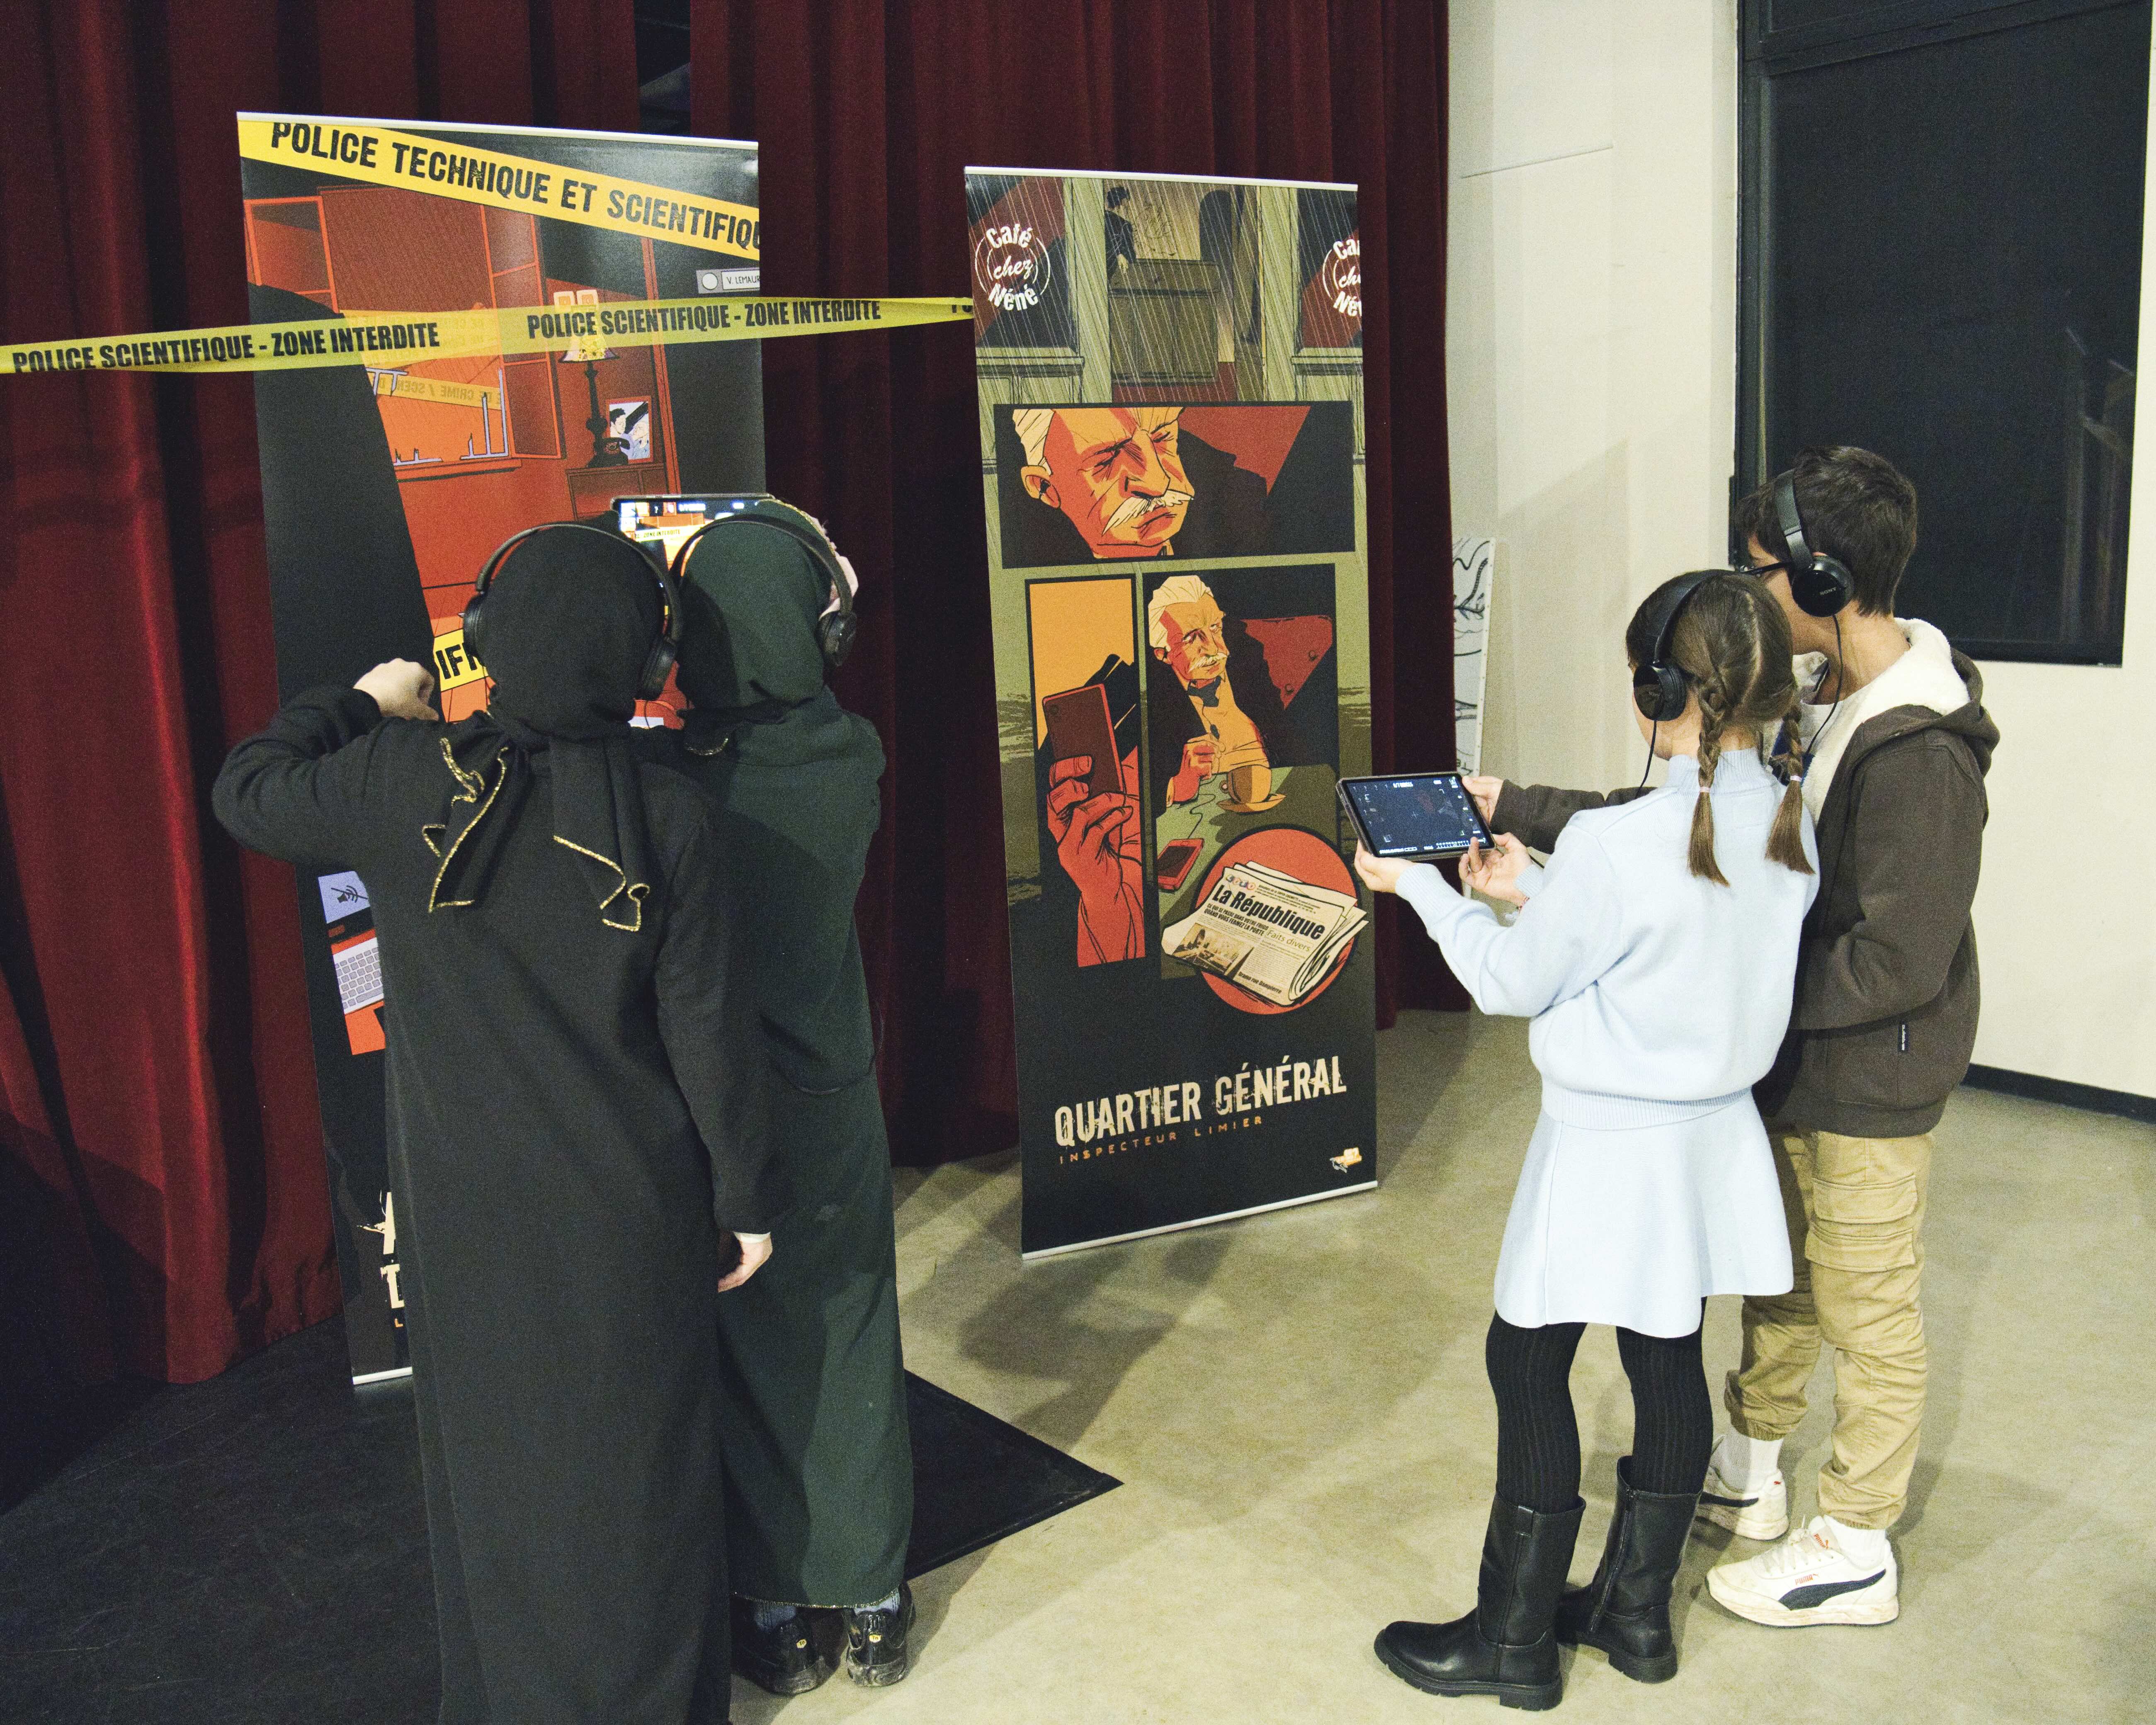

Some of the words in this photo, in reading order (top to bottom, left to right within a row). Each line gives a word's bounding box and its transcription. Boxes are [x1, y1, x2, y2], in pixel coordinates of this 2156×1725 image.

[272, 123, 378, 168] POLICE
[392, 143, 551, 204] TECHNIQUE
[561, 178, 597, 212] ET
[986, 224, 1033, 248] Café
[993, 255, 1033, 279] chez
[988, 283, 1038, 311] Néné
[527, 312, 597, 338] POLICE
[601, 305, 731, 334] SCIENTIFIQUE
[744, 301, 789, 326] ZONE
[793, 300, 881, 323] INTERDITE
[12, 347, 93, 373] POLICE
[99, 335, 255, 368] SCIENTIFIQUE
[272, 329, 326, 356] ZONE
[332, 323, 440, 353] INTERDITE
[1212, 884, 1231, 904] La
[1230, 891, 1326, 940] République
[1267, 928, 1285, 943] Faits
[1286, 937, 1311, 952] divers
[1055, 1082, 1202, 1148] QUARTIER
[1215, 1055, 1347, 1116] GÉNÉRAL
[1060, 1131, 1177, 1164] INSPECTEUR
[1195, 1116, 1263, 1137] LIMIER
